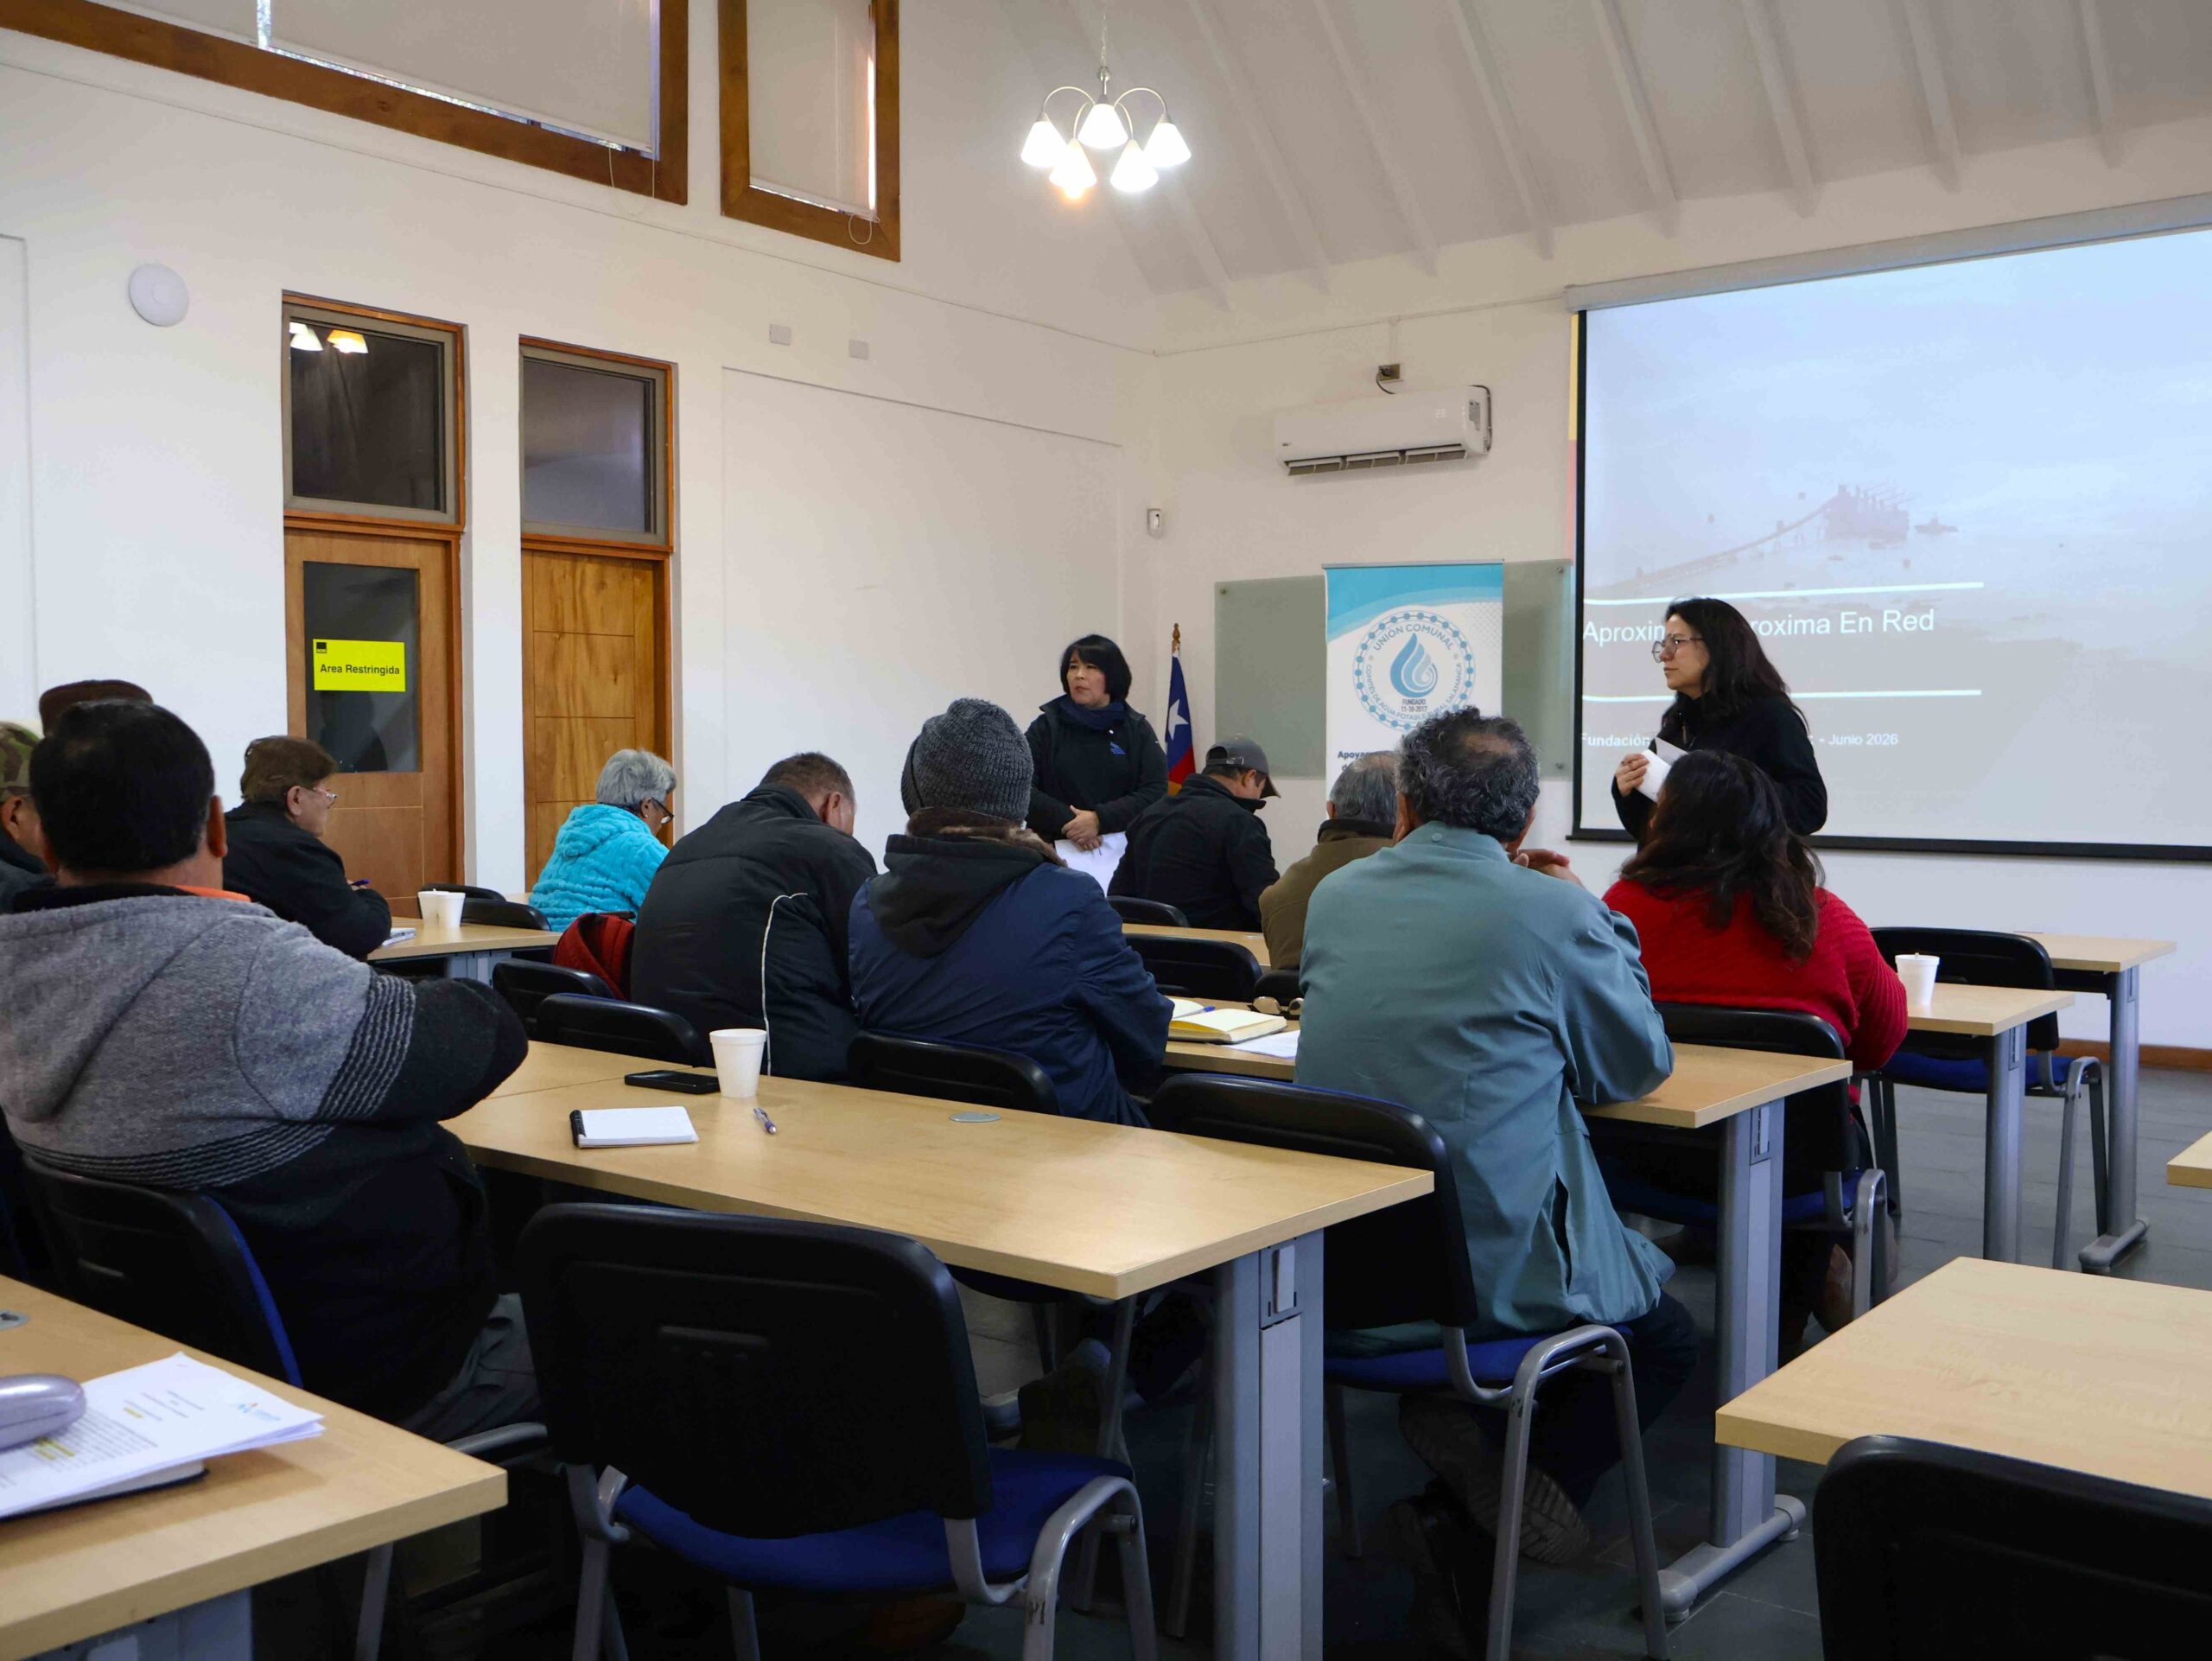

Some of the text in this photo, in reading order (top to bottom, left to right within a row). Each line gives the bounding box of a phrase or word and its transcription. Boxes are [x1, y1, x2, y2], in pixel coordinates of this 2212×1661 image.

[1751, 614, 1830, 636] roxima
[1840, 611, 1872, 633] En
[1883, 608, 1935, 632] Red
[1405, 623, 1453, 651] COMUNAL
[320, 664, 400, 677] Area Restringida
[1828, 733, 1863, 746] Junio
[1866, 733, 1898, 746] 2026
